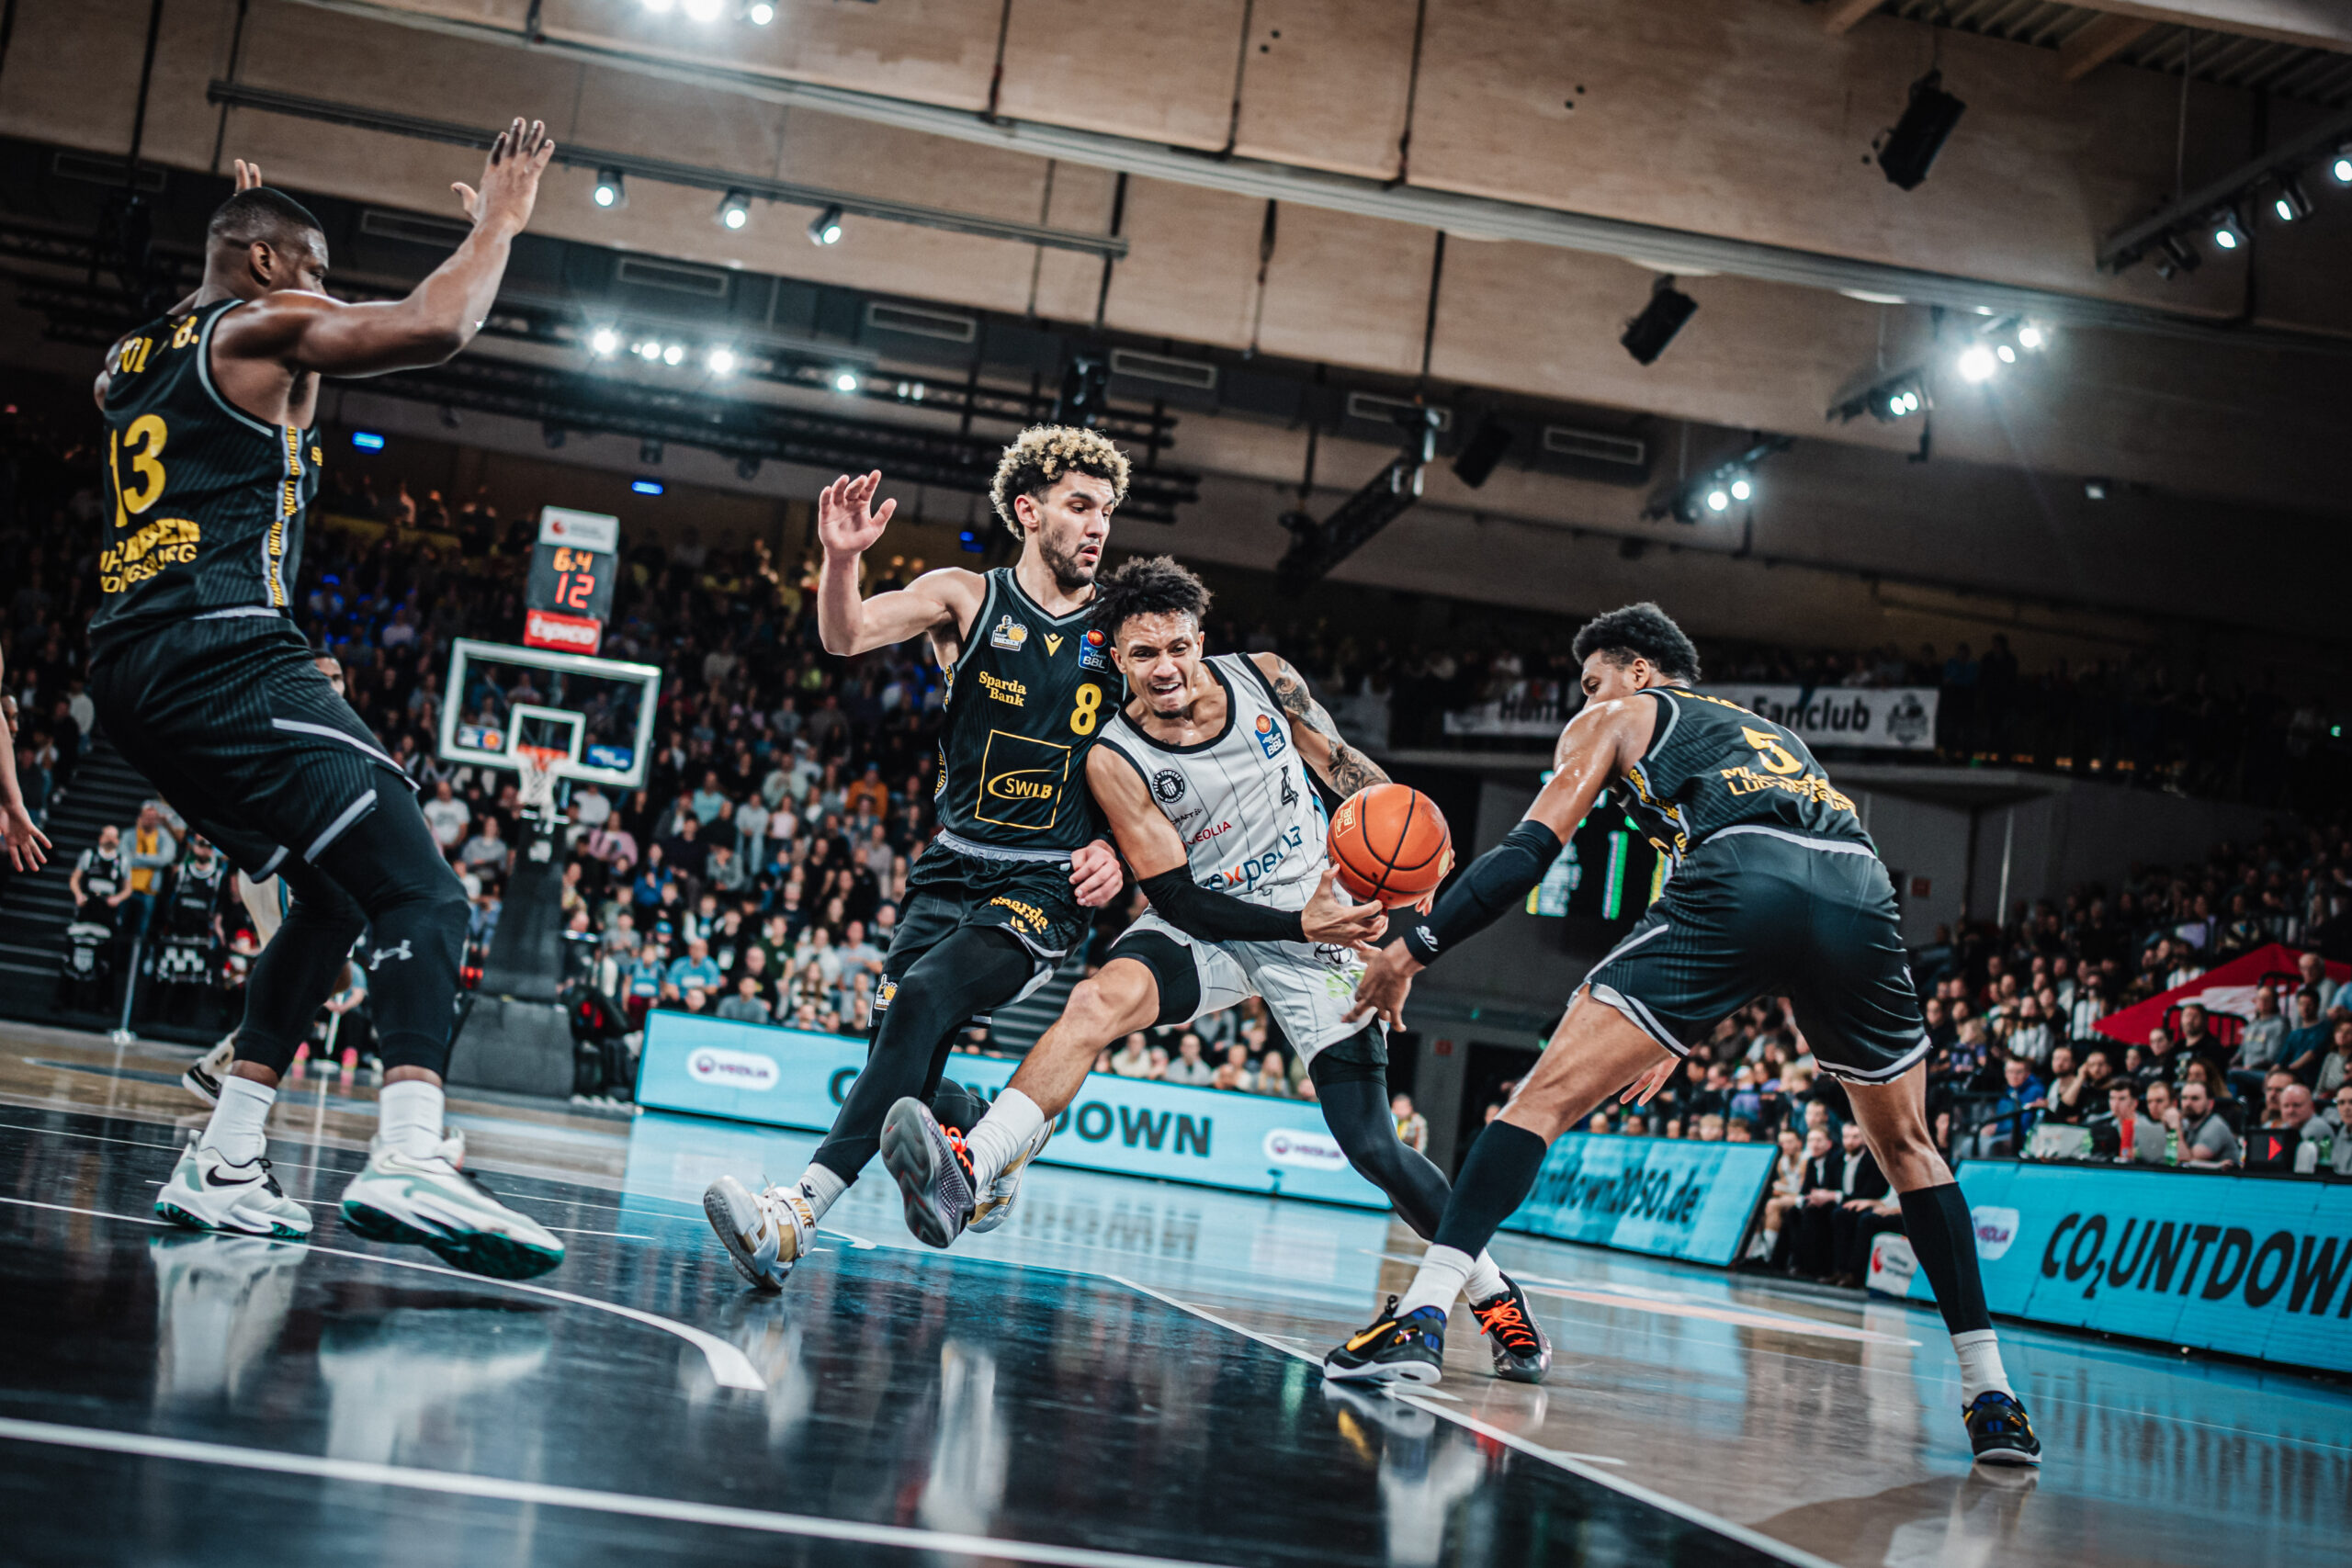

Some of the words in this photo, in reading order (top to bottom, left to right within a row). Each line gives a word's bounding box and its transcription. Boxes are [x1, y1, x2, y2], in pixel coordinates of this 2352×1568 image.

[109, 413, 168, 528] 13
[554, 572, 596, 610] 12
[1082, 656, 1105, 669] BBL
[978, 671, 1027, 695] Sparda
[989, 687, 1024, 707] Bank
[1069, 682, 1102, 736] 8
[1267, 738, 1284, 756] BBL
[1741, 726, 1803, 774] 5
[1004, 777, 1053, 799] SWLB
[1281, 764, 1299, 809] 4
[789, 1197, 815, 1229] NIKE
